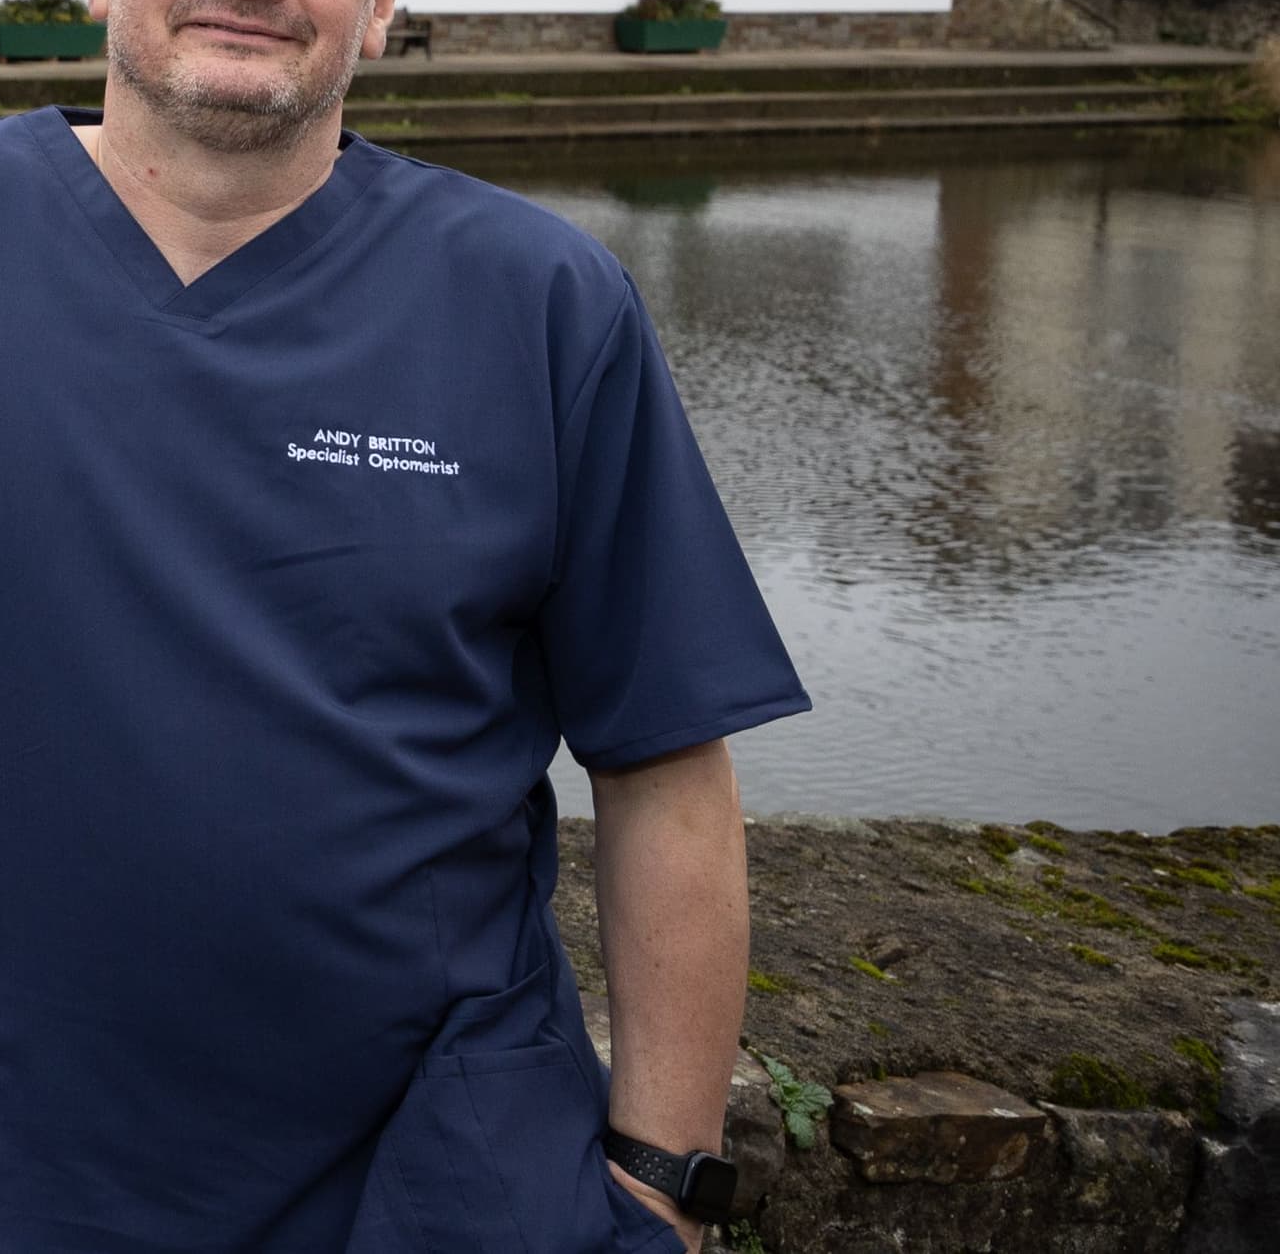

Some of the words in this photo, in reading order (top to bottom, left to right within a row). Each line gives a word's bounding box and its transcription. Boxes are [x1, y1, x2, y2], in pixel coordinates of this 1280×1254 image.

[313, 428, 362, 448] ANDY
[368, 436, 436, 456] BRITTON
[287, 443, 361, 466] Specialist
[368, 453, 461, 475] Optometrist
